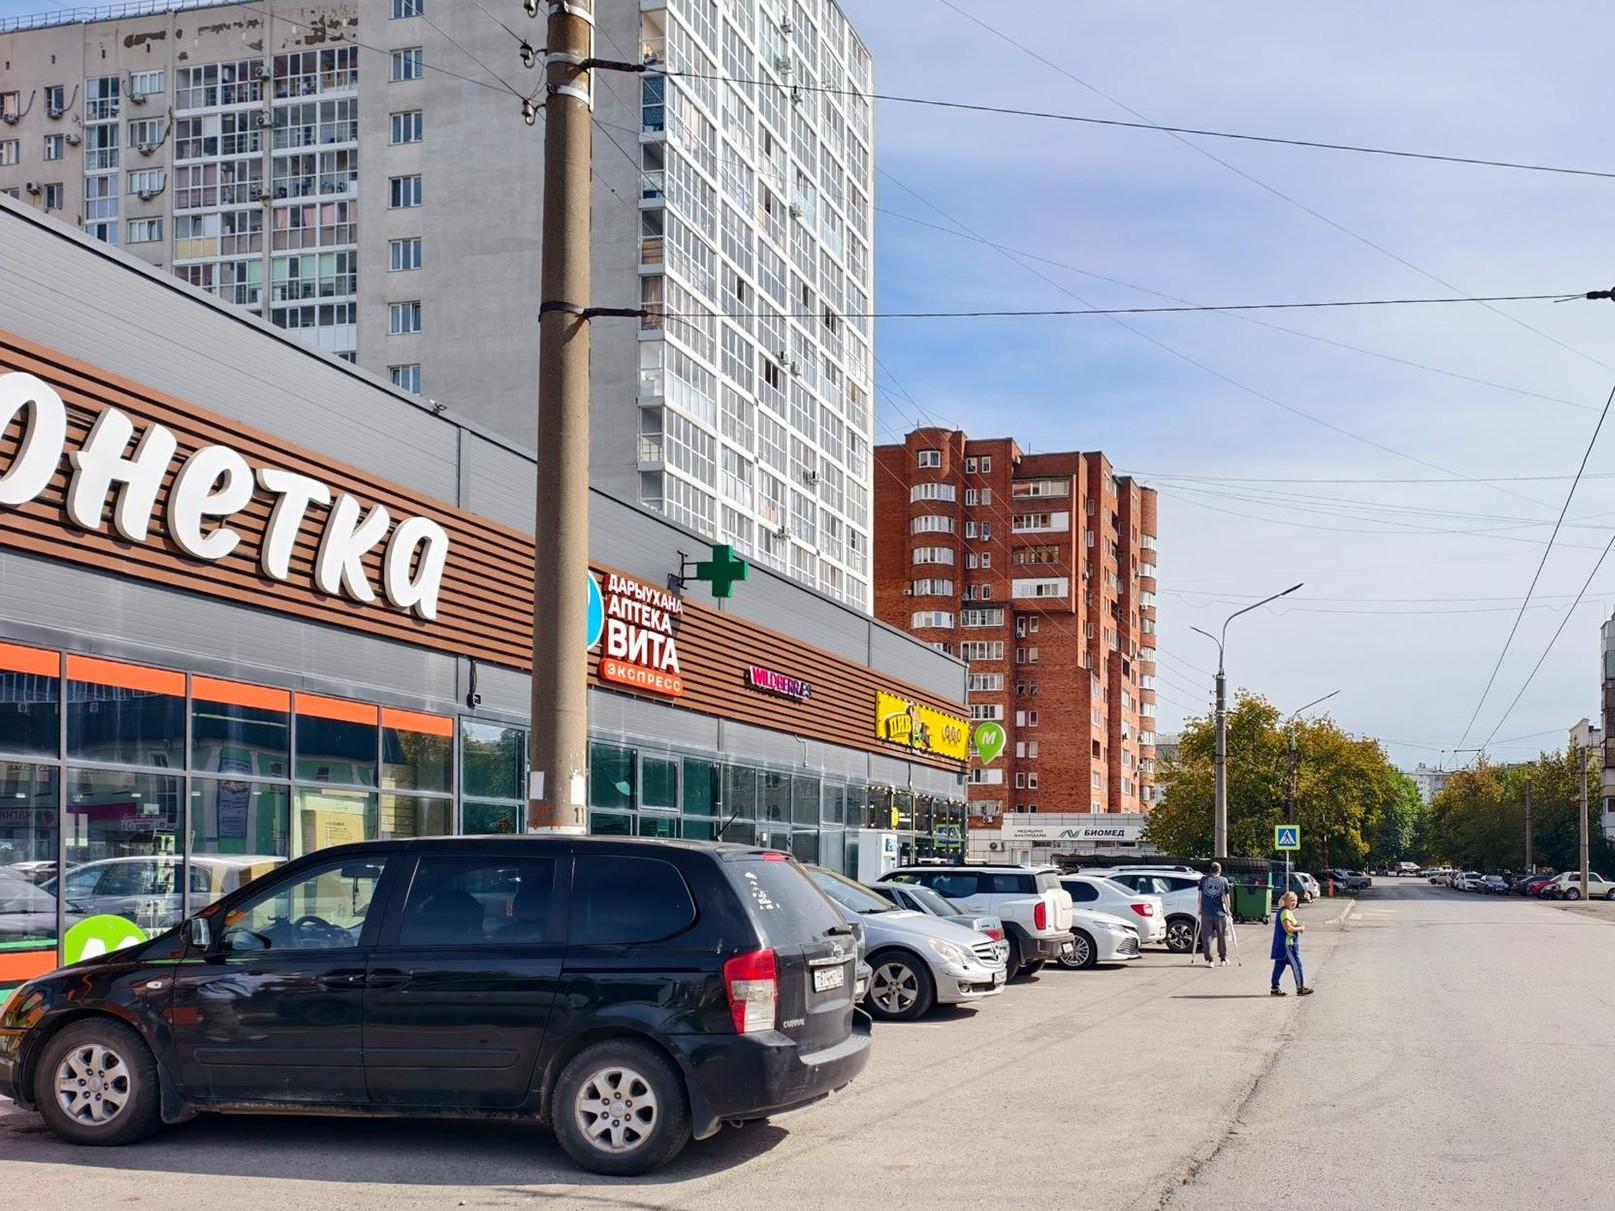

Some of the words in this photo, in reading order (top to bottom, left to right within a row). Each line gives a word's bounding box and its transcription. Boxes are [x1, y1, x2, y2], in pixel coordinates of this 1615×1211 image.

[608, 574, 684, 615] ДАРЫУХАНА
[608, 594, 672, 635] АПТЕКА
[607, 618, 681, 674] ВИТА
[607, 664, 682, 692] ЭКСПРЕСС
[1084, 829, 1125, 837] БИОМЕД
